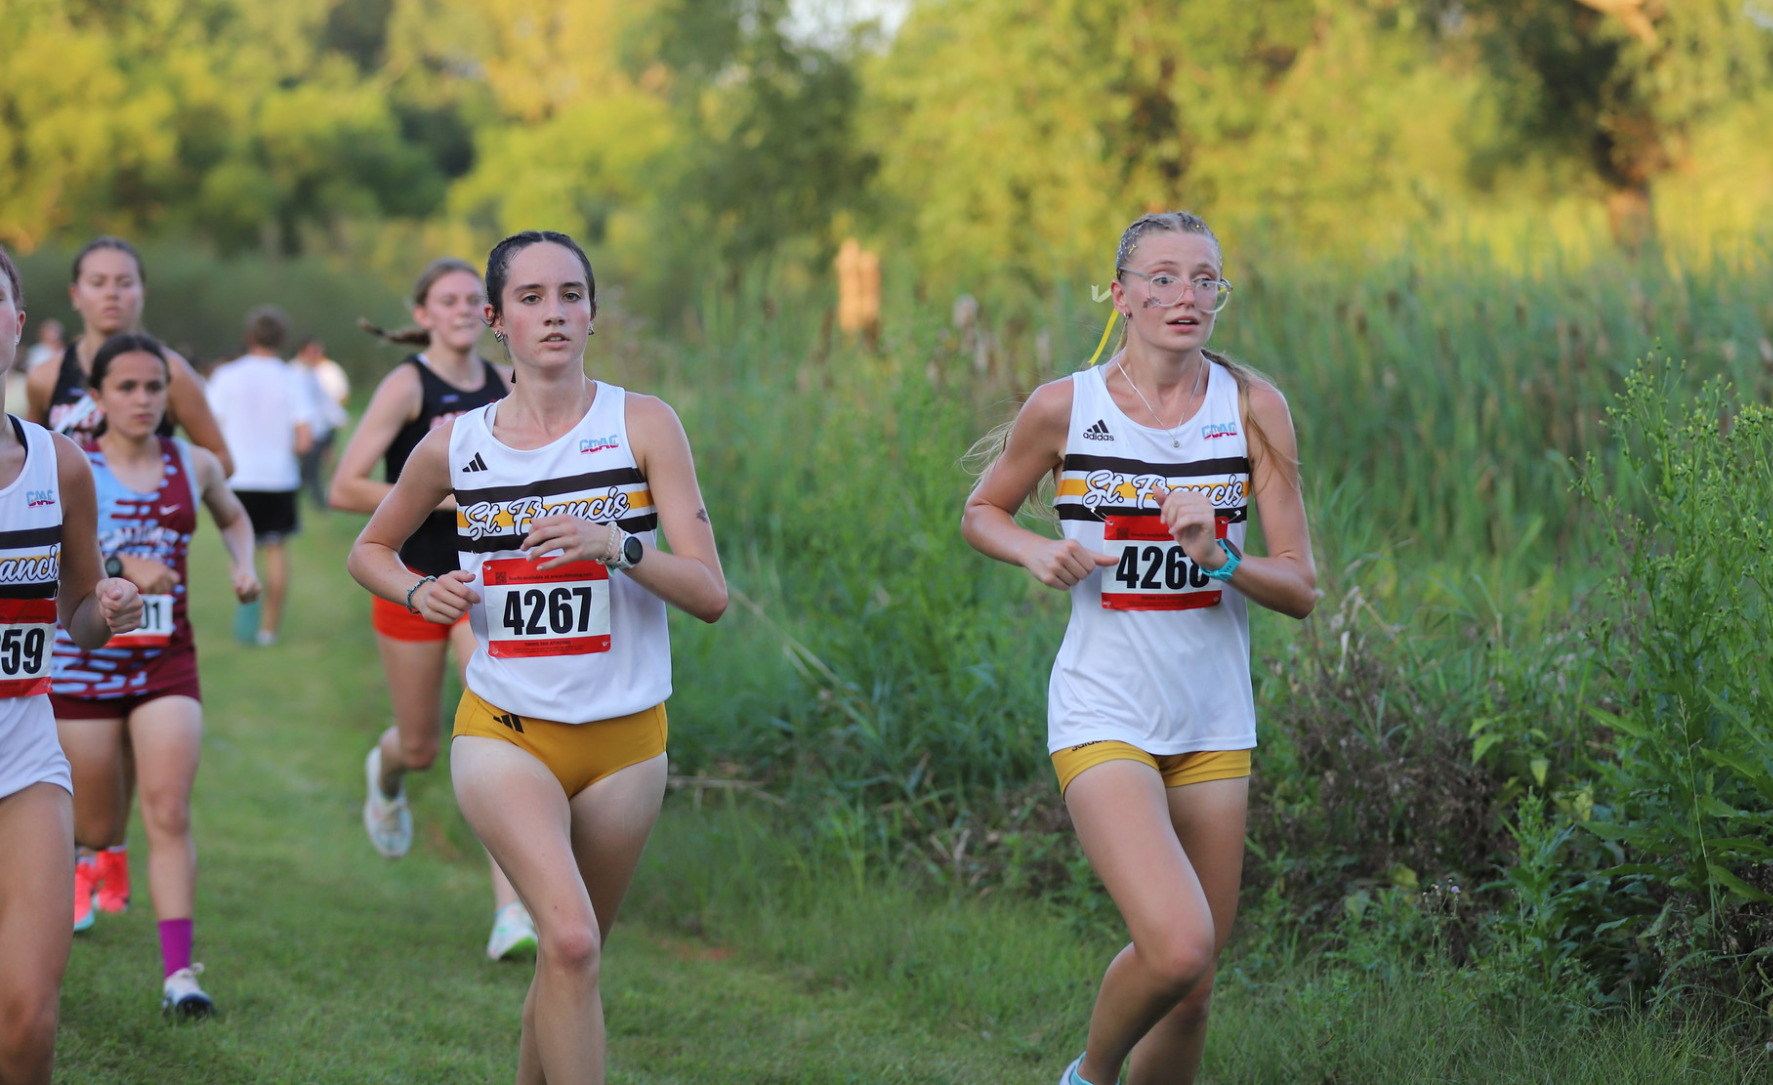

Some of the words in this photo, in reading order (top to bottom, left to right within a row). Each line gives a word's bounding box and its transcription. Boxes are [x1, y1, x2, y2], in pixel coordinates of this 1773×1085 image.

[1083, 431, 1115, 442] adidas
[1082, 469, 1125, 509] St.
[1131, 473, 1244, 510] Frncis
[465, 501, 502, 541] St.
[139, 599, 160, 630] 01
[503, 586, 592, 635] 4267
[0, 627, 45, 676] 59
